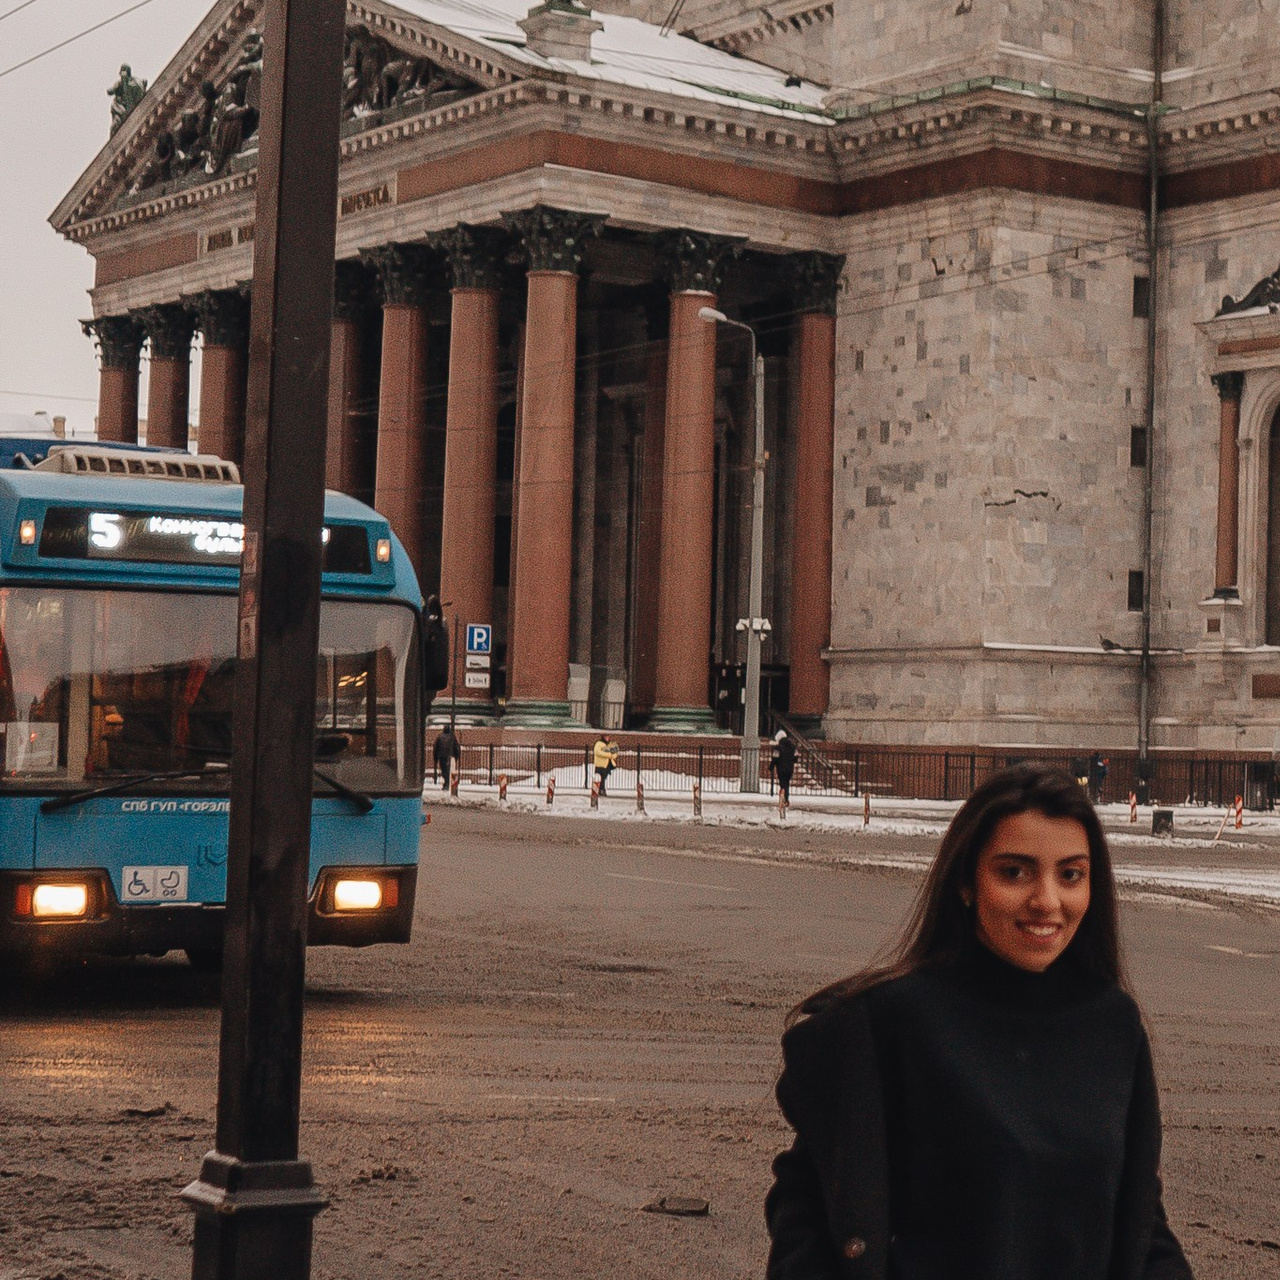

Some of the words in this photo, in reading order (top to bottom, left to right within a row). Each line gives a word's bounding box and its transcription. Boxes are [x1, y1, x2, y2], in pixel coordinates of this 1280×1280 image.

[91, 512, 122, 548] 5
[473, 627, 487, 650] P
[150, 801, 176, 812] ГУП
